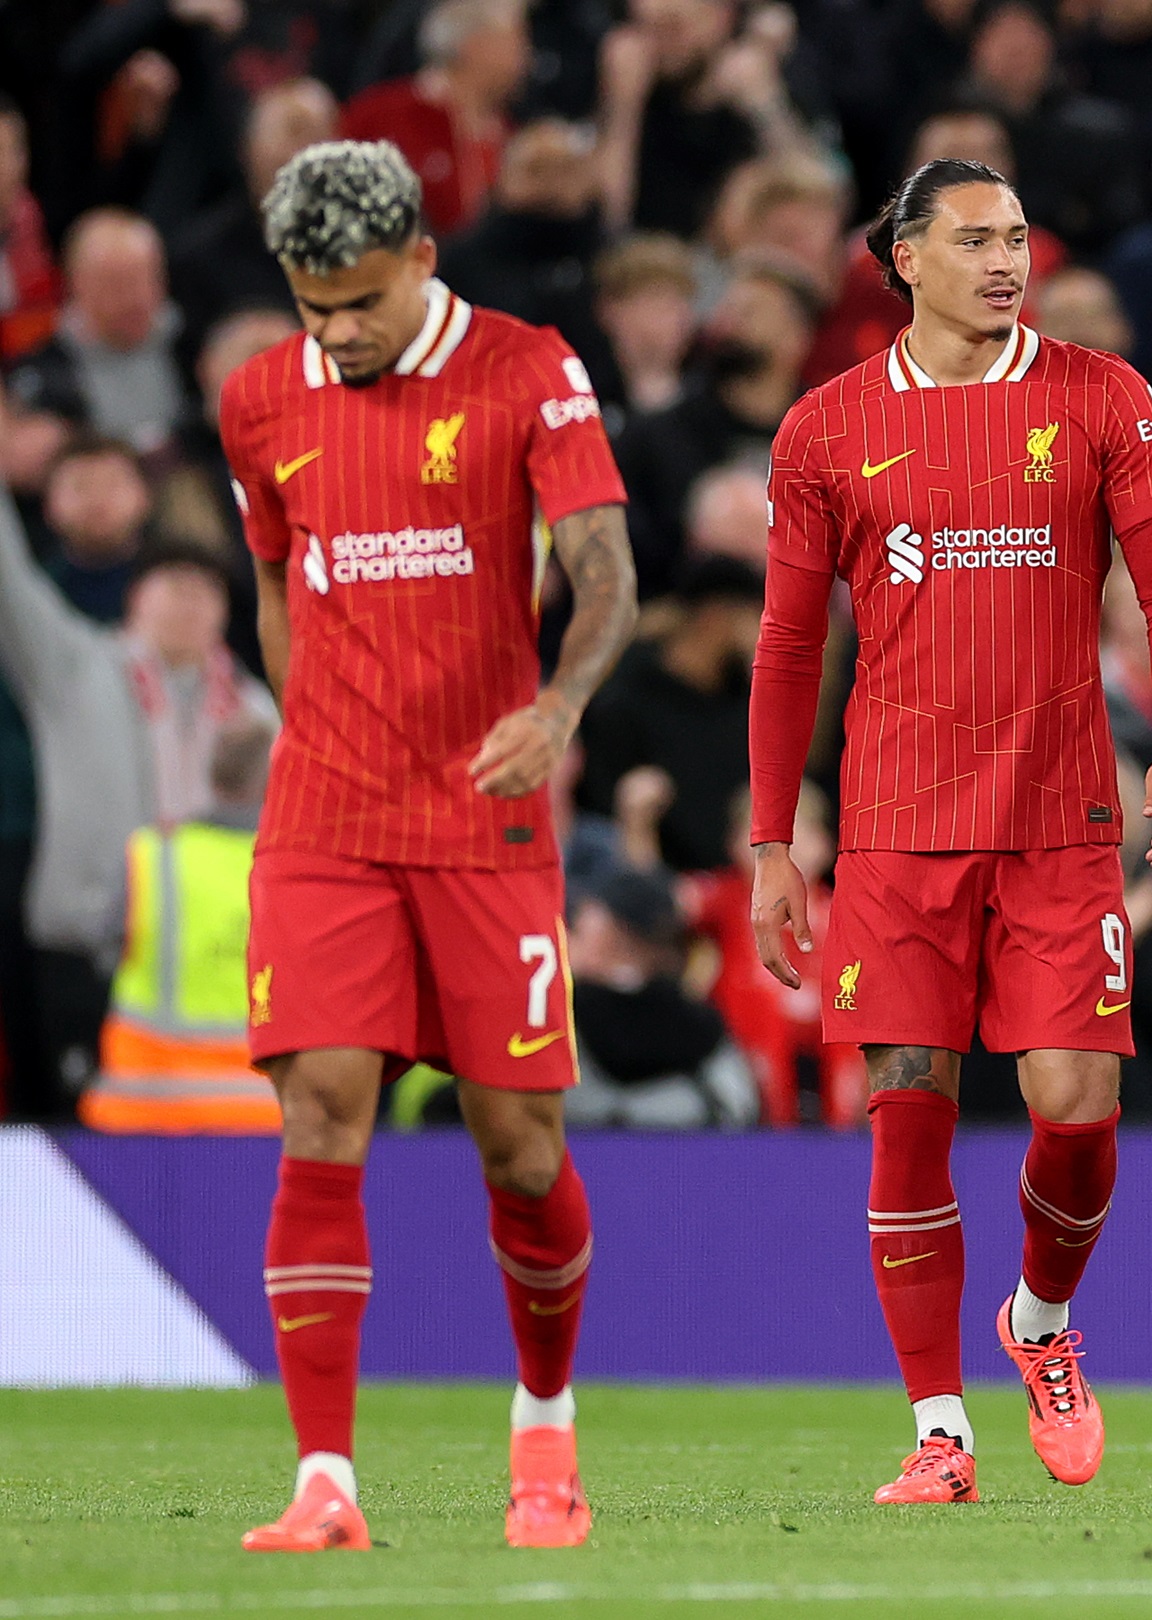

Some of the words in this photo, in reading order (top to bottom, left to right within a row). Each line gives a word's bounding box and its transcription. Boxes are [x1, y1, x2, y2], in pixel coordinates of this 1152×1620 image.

[331, 522, 464, 560] standard
[931, 523, 1051, 549] standard
[332, 545, 475, 583] chartered
[931, 545, 1056, 570] chartered
[1100, 912, 1128, 992] 9
[518, 934, 558, 1028] 7
